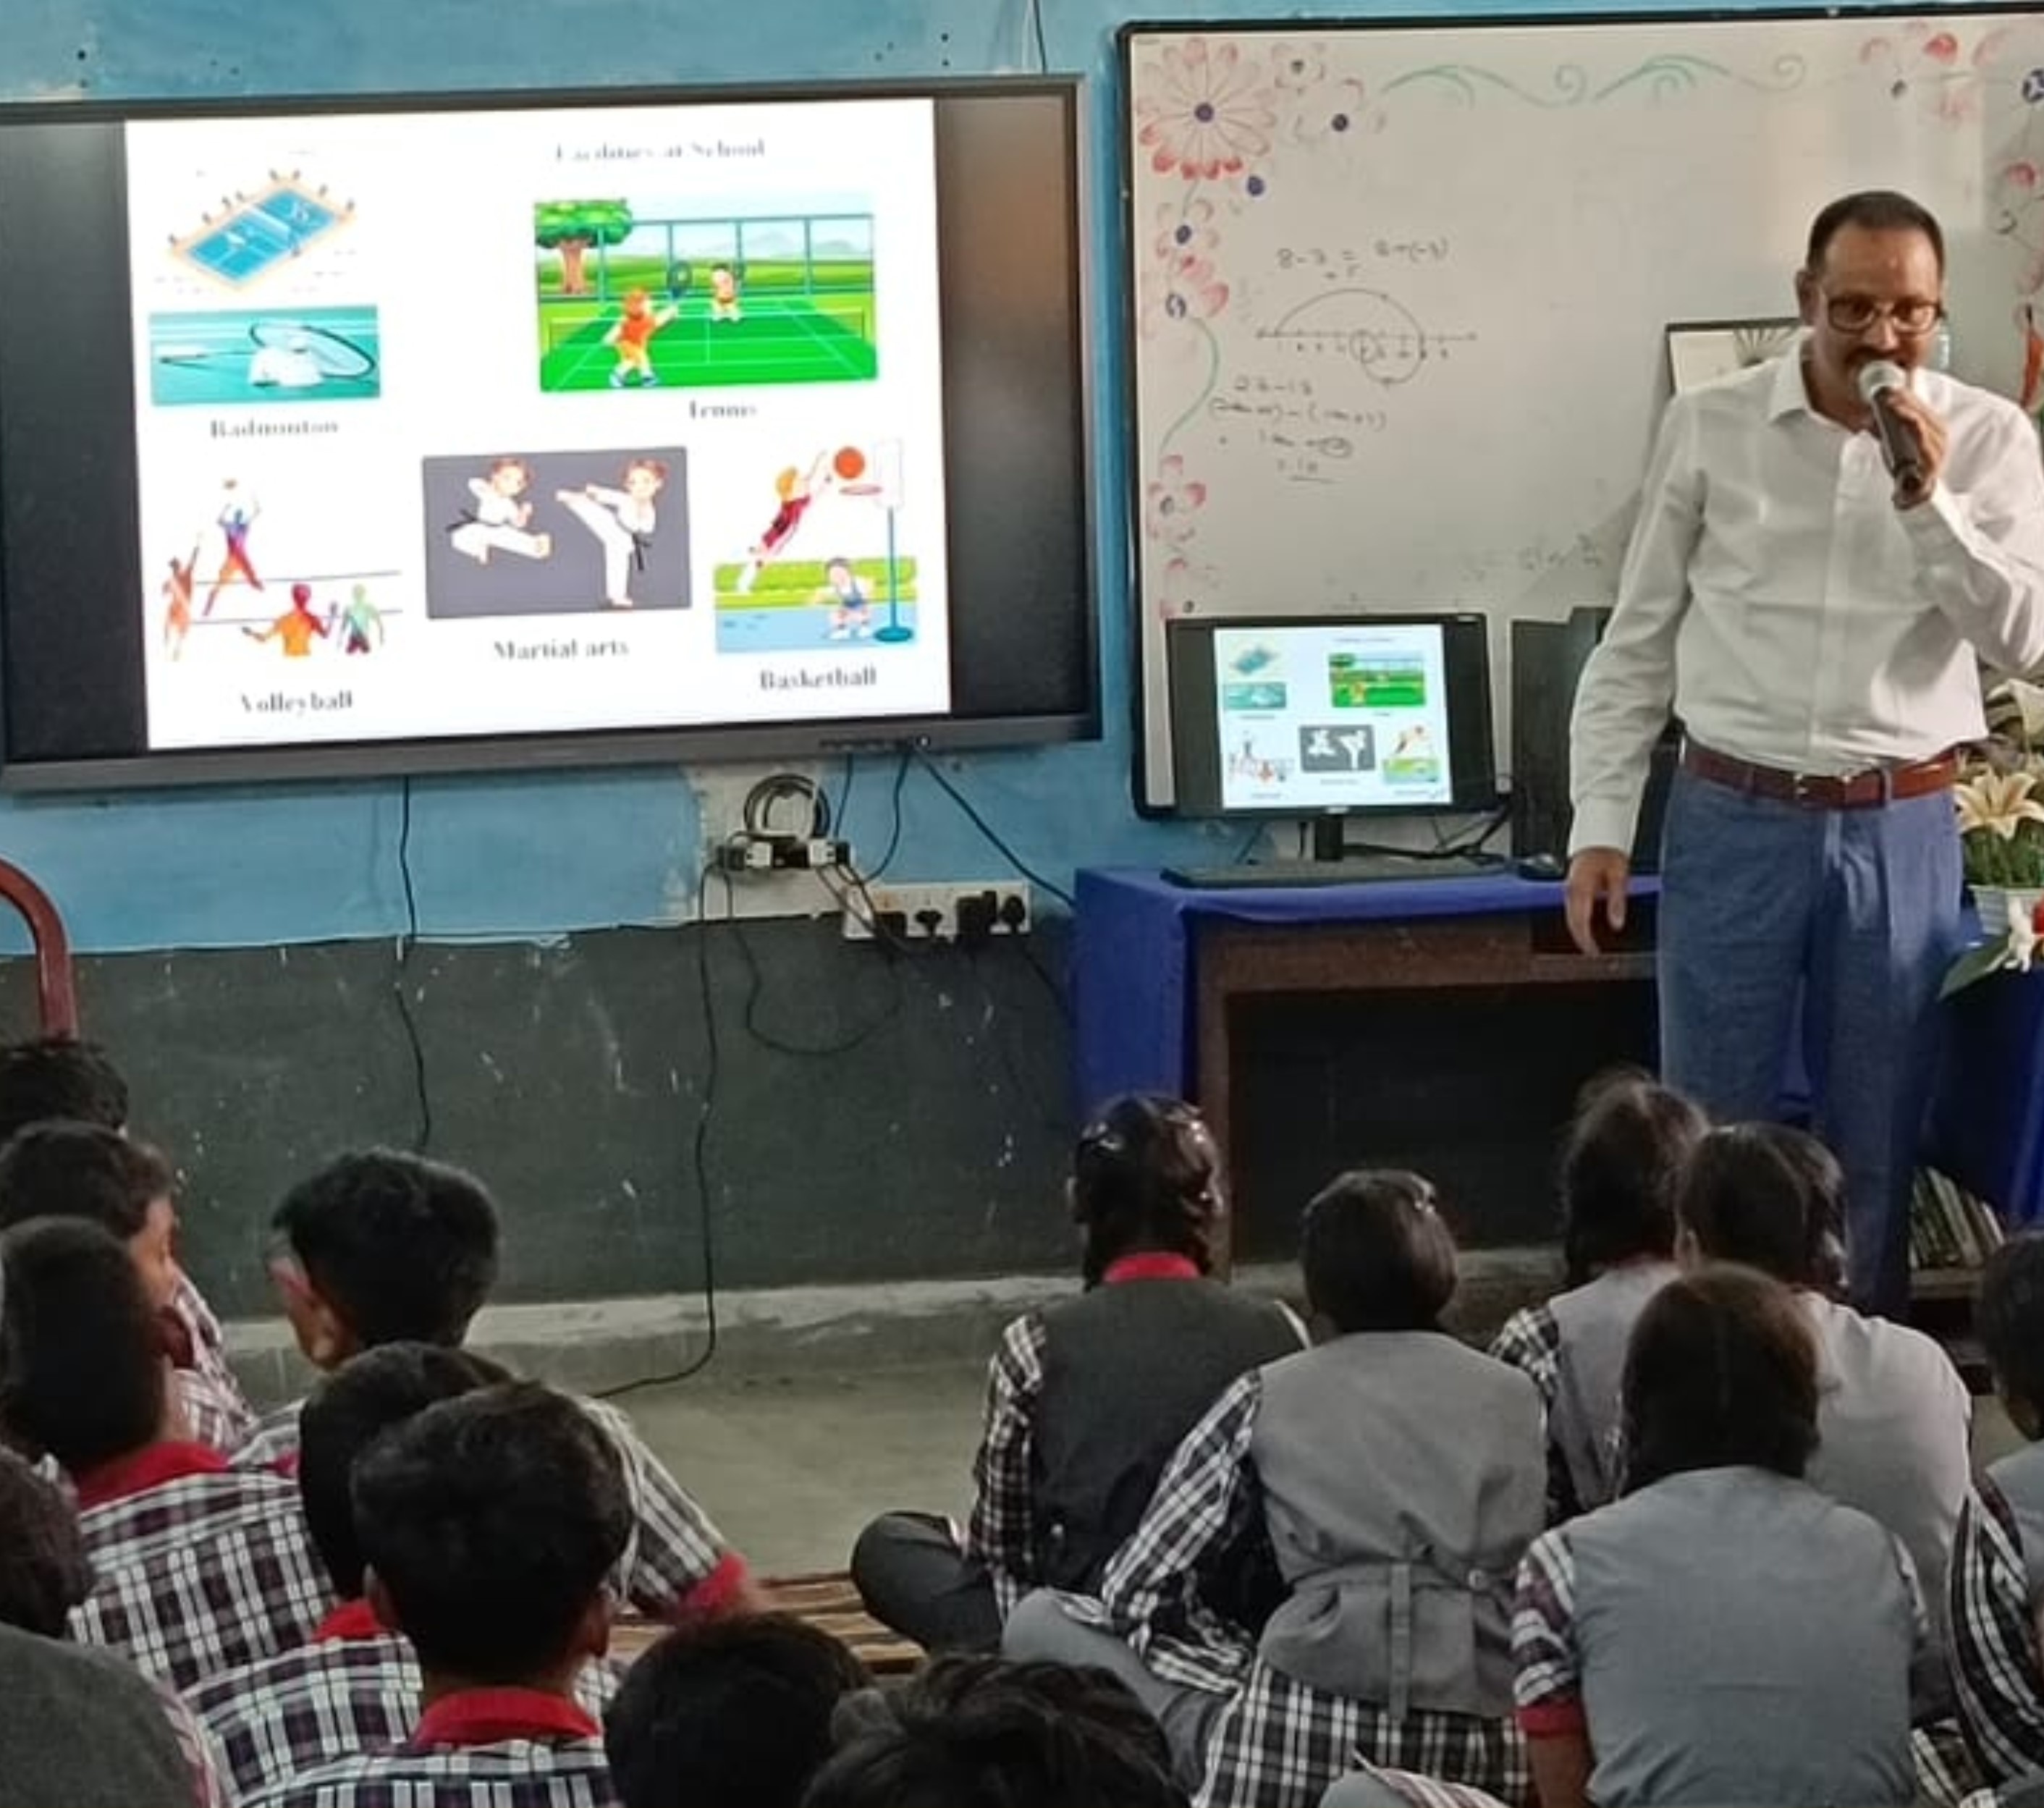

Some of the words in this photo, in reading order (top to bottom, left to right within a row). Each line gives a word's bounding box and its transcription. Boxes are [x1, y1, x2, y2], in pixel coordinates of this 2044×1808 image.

[494, 637, 578, 662] Martial
[586, 638, 629, 659] arts
[759, 664, 877, 691] Basketball
[240, 688, 353, 718] Volleyball
